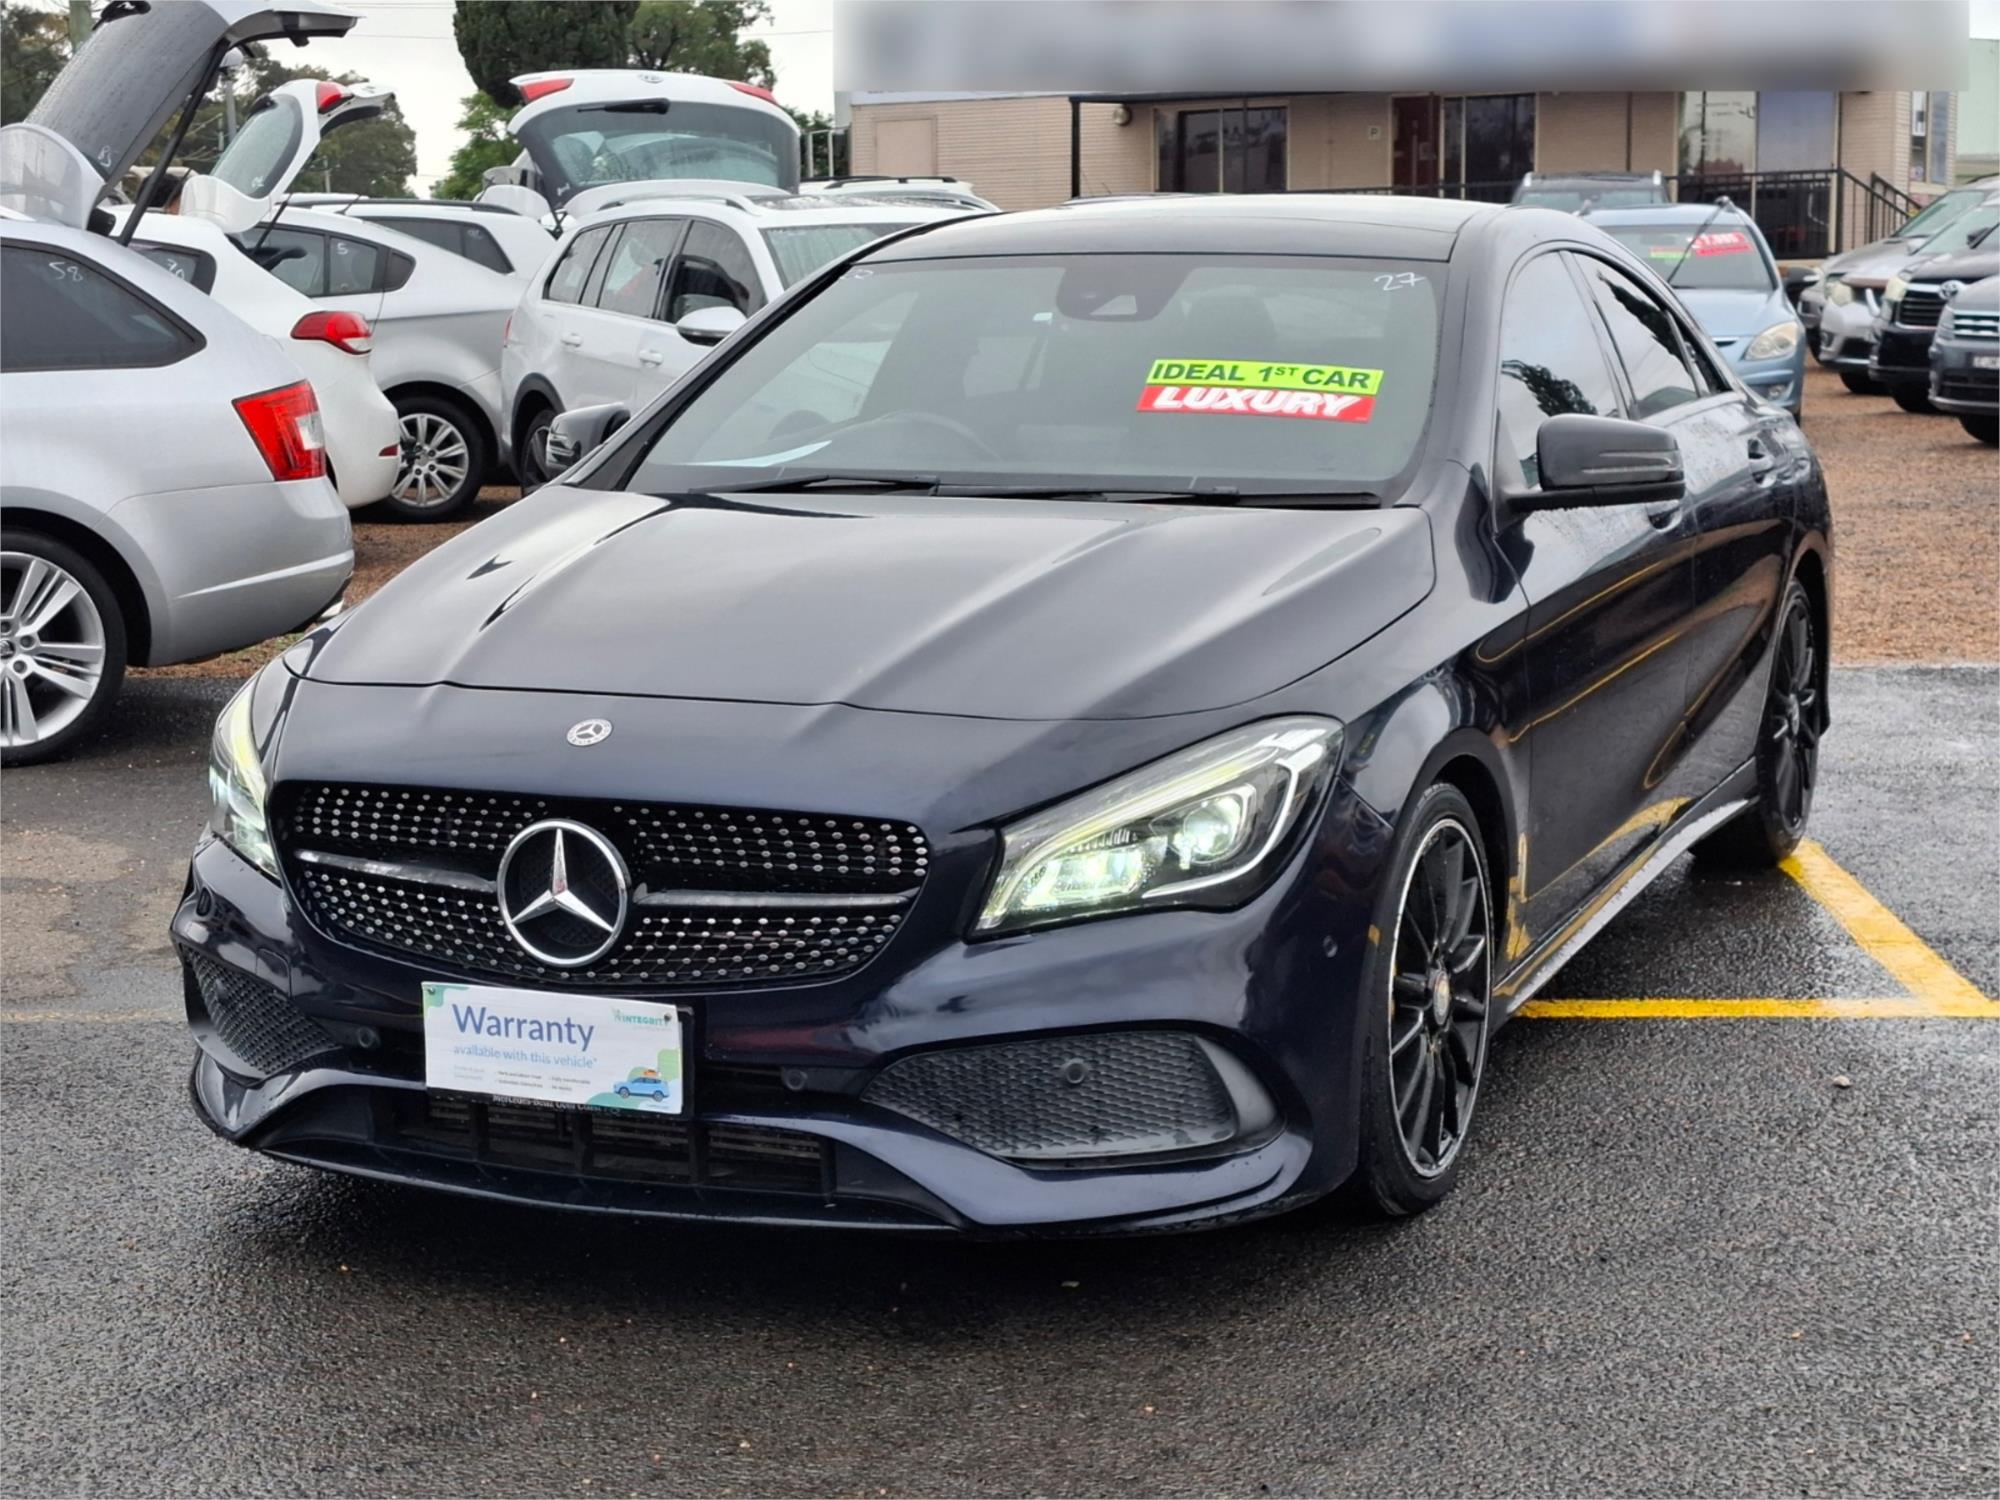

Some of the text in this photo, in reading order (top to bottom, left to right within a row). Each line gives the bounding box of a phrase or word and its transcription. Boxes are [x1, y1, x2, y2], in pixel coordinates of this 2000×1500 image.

[1373, 271, 1426, 291] 27
[1152, 362, 1246, 382] IDEAL
[1302, 368, 1371, 389] CAR
[1152, 386, 1362, 417] LUXURY
[452, 1003, 595, 1052] Warranty
[453, 1044, 501, 1060] available
[502, 1050, 529, 1062] with
[530, 1052, 552, 1065] this
